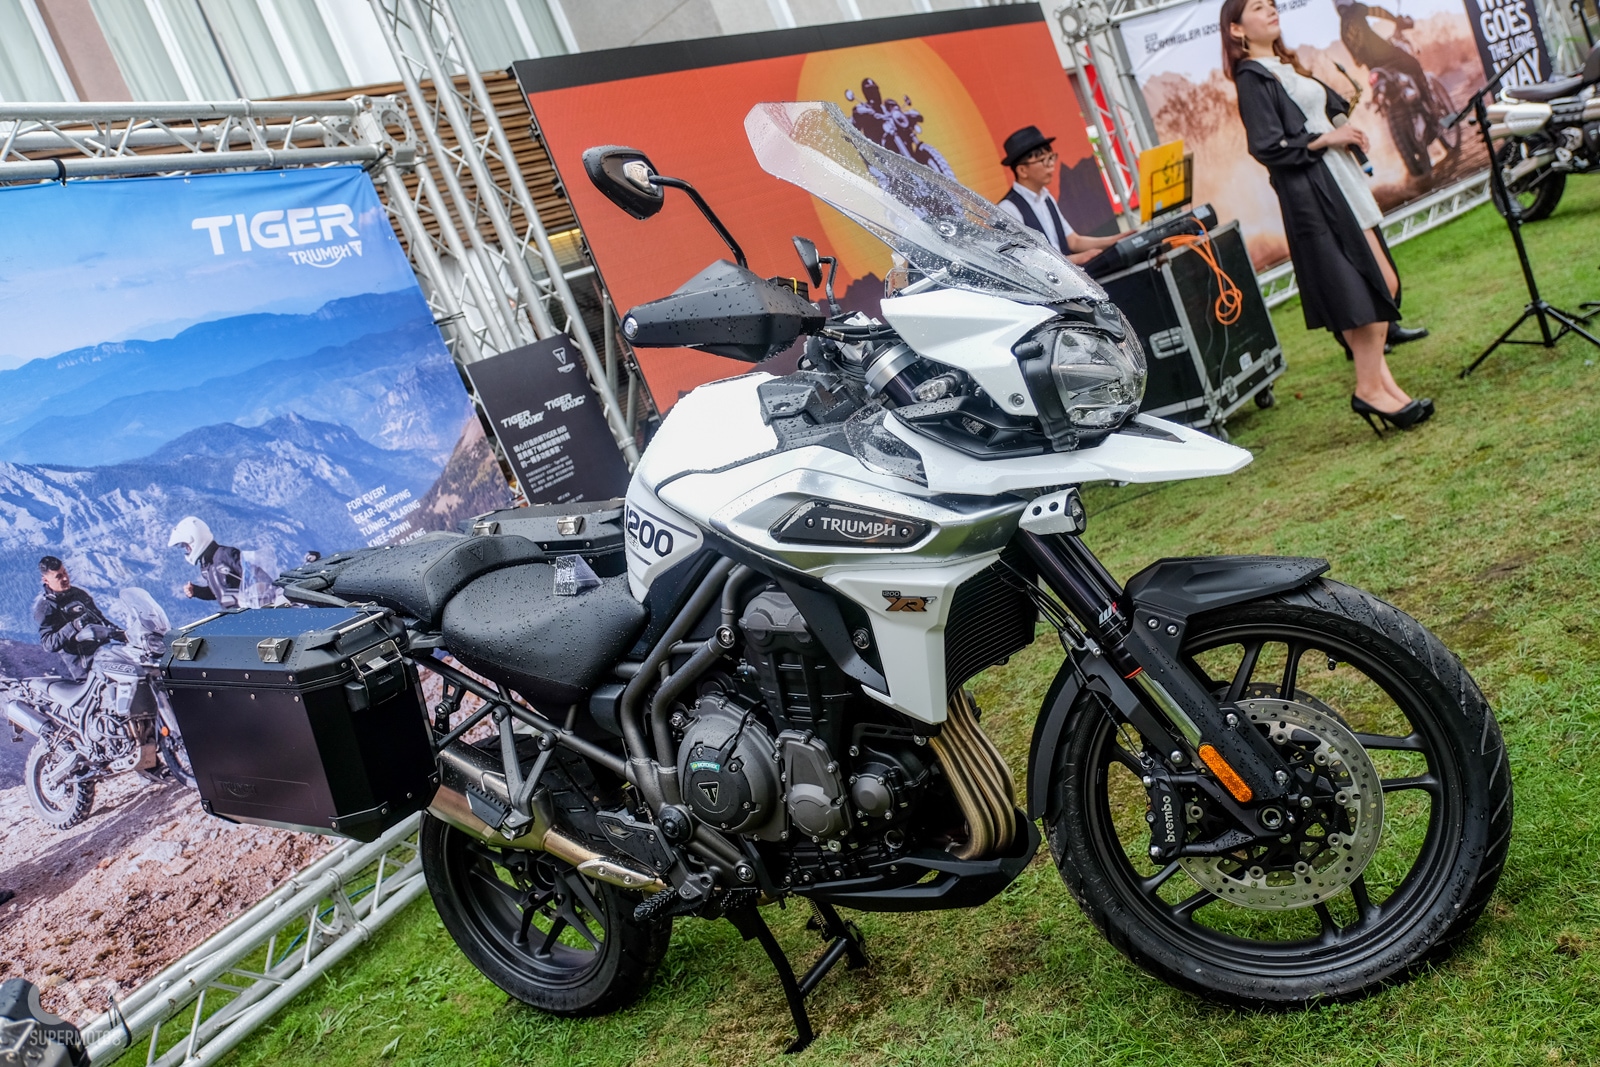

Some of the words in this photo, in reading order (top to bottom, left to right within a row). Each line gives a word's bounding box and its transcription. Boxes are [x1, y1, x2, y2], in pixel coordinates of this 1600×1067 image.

[1480, 1, 1532, 43] GOES
[1487, 39, 1512, 62] THE
[1509, 30, 1537, 56] LONG
[1493, 47, 1542, 88] WAY
[191, 203, 360, 256] TIGER
[288, 244, 353, 268] TRIUMPH
[544, 393, 572, 411] TIGER
[501, 410, 530, 428] TIGER
[345, 497, 364, 512] FOR
[361, 484, 388, 504] EVERY
[353, 488, 412, 525] GEAR-DROPPING
[359, 499, 421, 537] TUNNEL-BLARING
[367, 520, 412, 548] KNEE-DOWN
[625, 504, 674, 558] 1200
[820, 517, 897, 540] TRIUMPH
[882, 590, 901, 598] 1200
[1160, 795, 1176, 843] brembo
